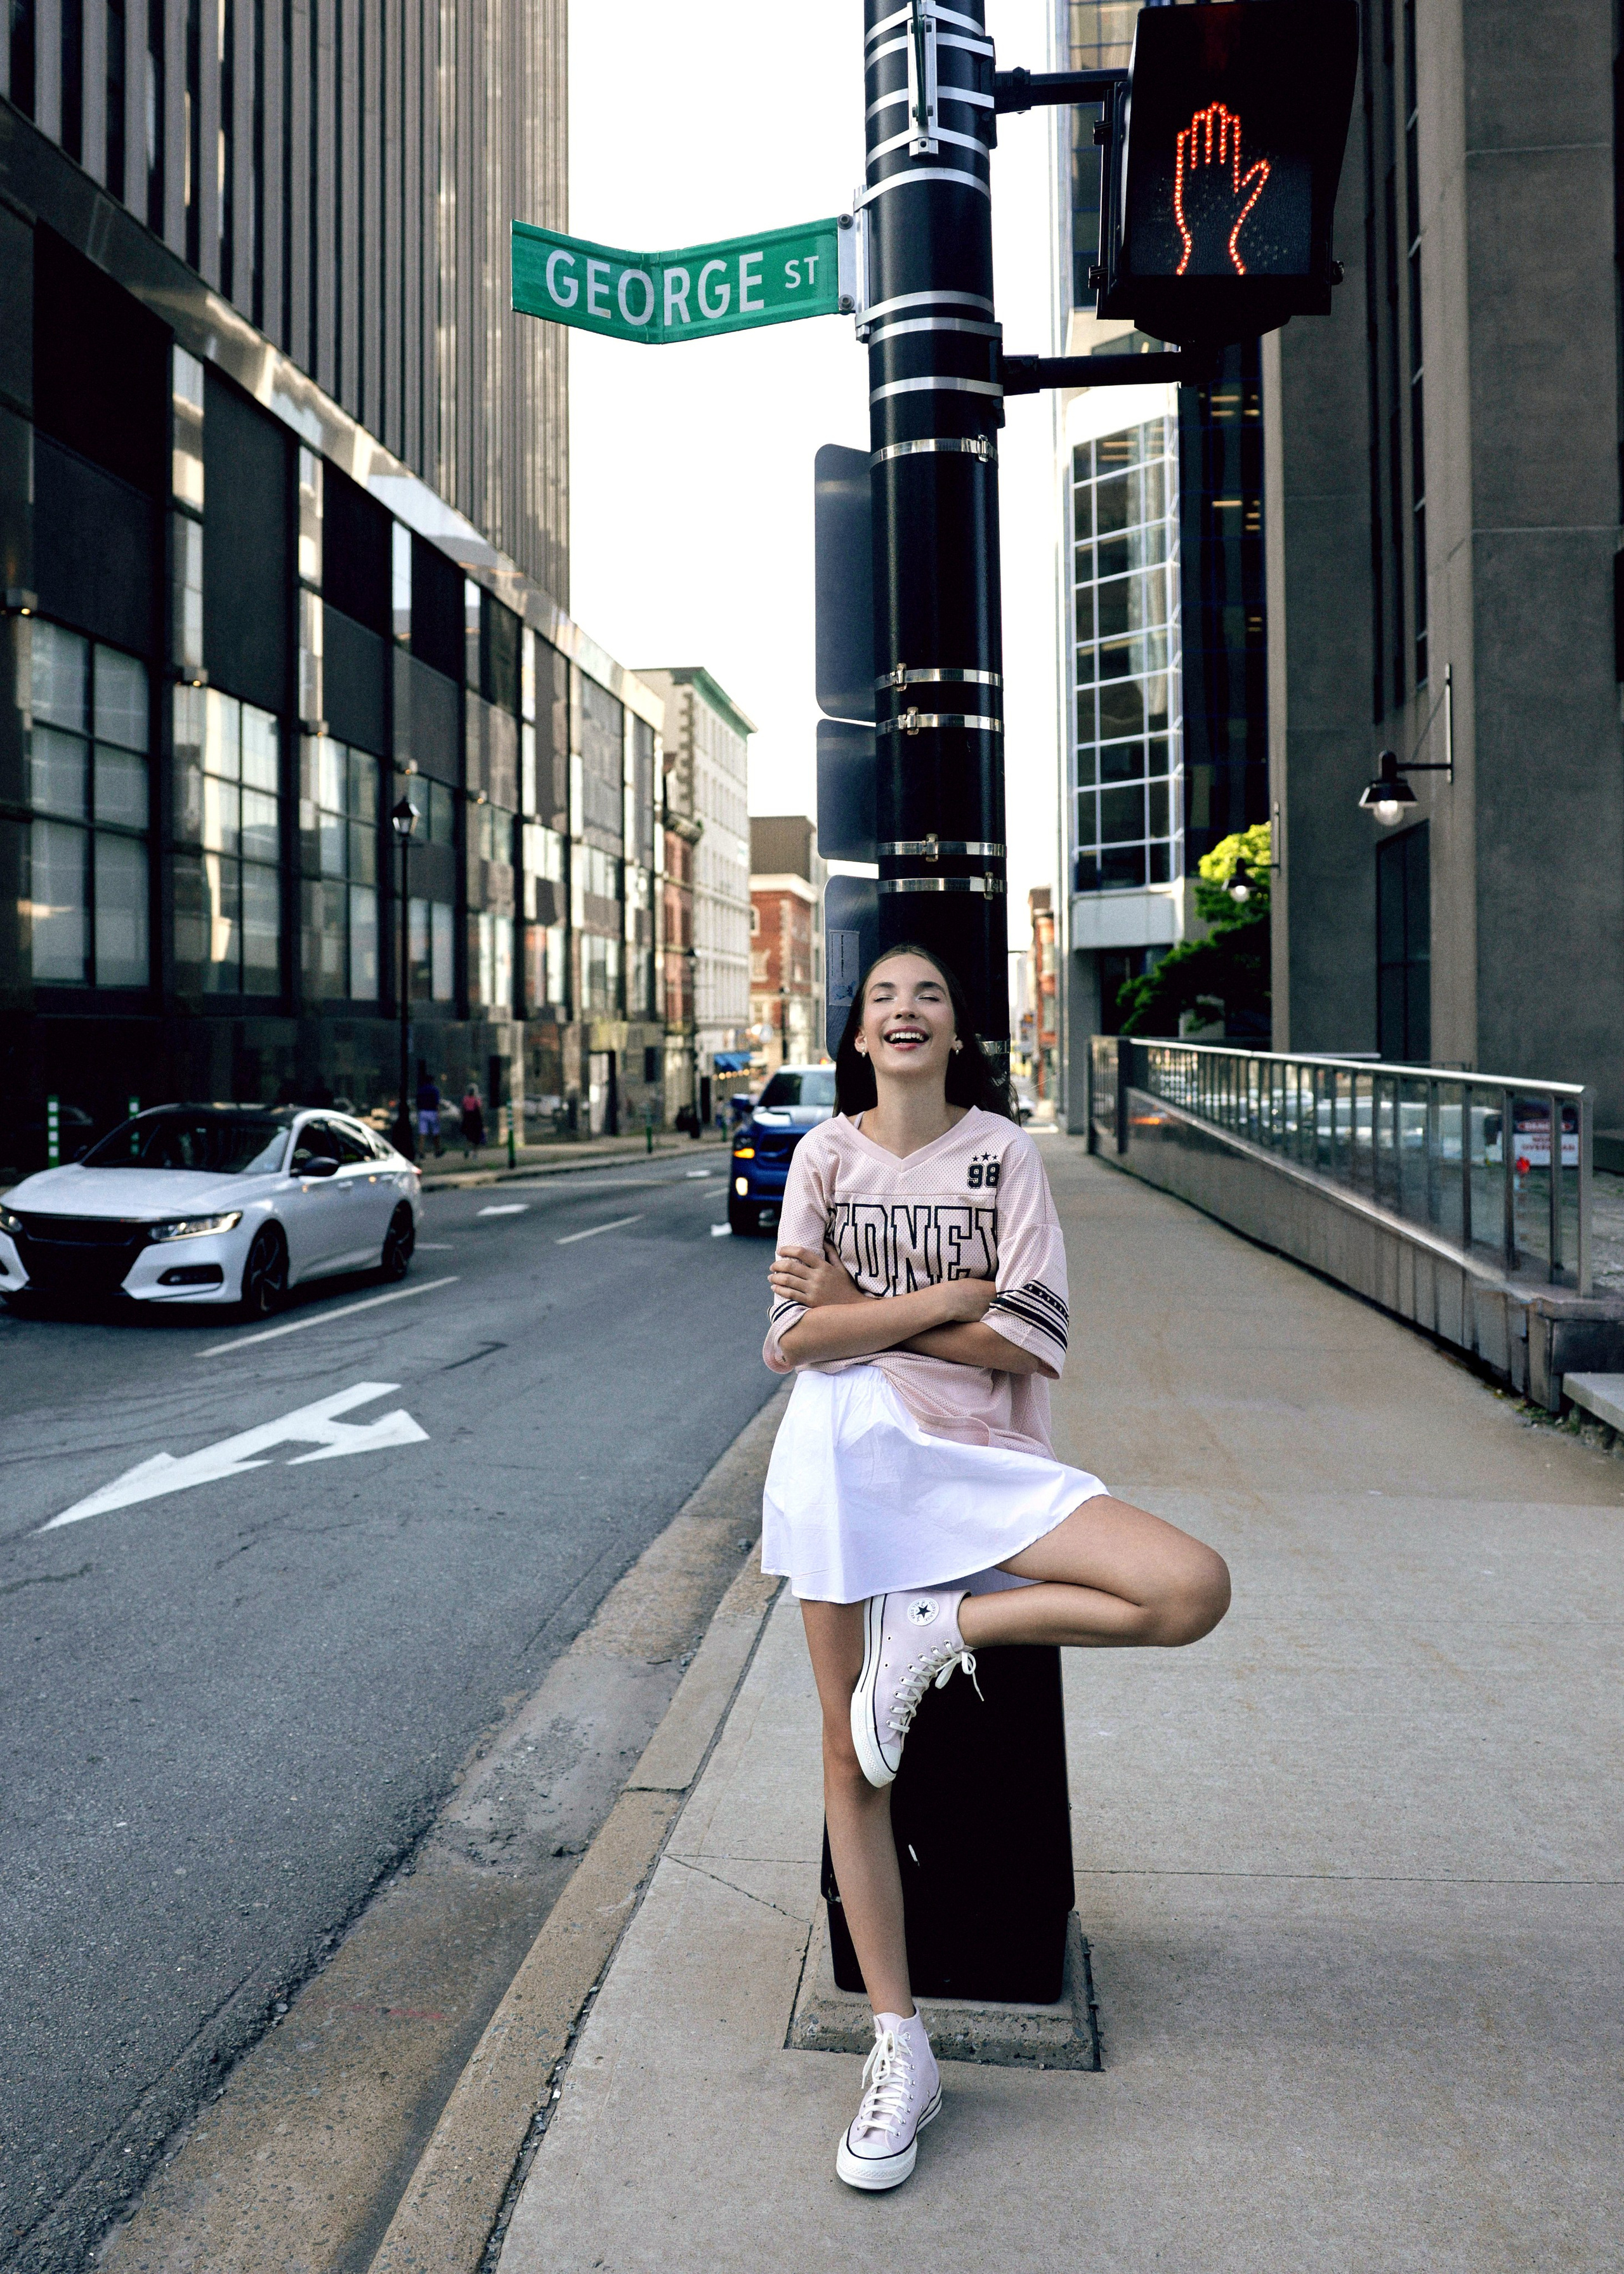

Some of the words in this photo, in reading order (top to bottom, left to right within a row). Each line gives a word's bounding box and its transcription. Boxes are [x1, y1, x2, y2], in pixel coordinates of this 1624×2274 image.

[546, 249, 764, 326] GEORGE
[785, 255, 820, 289] ST
[967, 1161, 1002, 1189] 98
[827, 1203, 997, 1298] DNE
